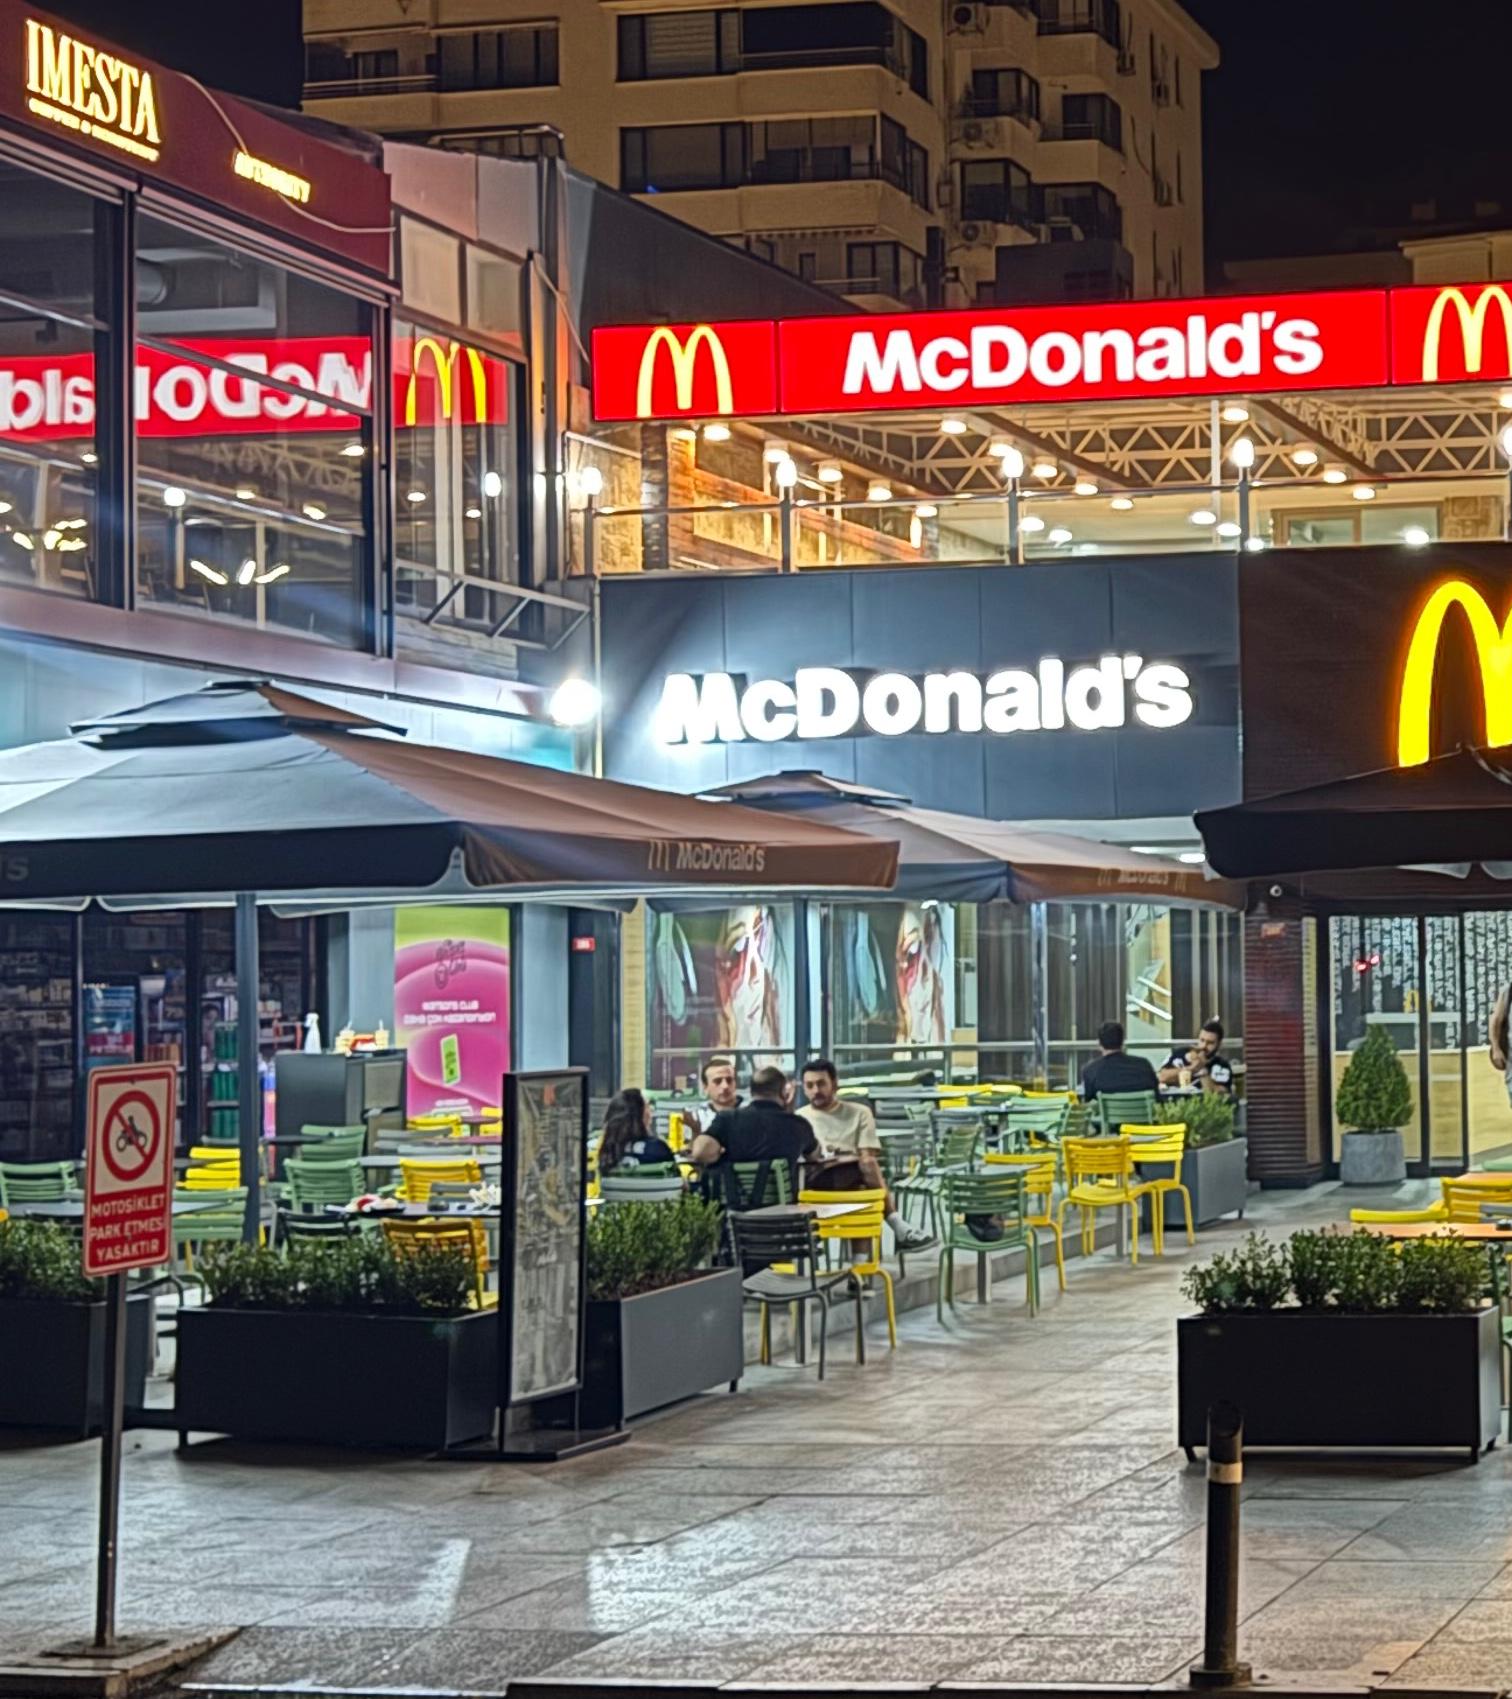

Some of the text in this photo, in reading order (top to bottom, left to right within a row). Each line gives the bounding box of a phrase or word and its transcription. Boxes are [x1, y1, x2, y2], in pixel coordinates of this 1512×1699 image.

[26, 19, 161, 143] IMESTA
[843, 311, 1323, 394] McDonald's
[653, 656, 1192, 745] McDonald's
[676, 841, 765, 872] McDonald's
[91, 1194, 165, 1217] MOTOSİKLET
[89, 1222, 122, 1241] PARK
[96, 1239, 160, 1262] YASAKTIR
